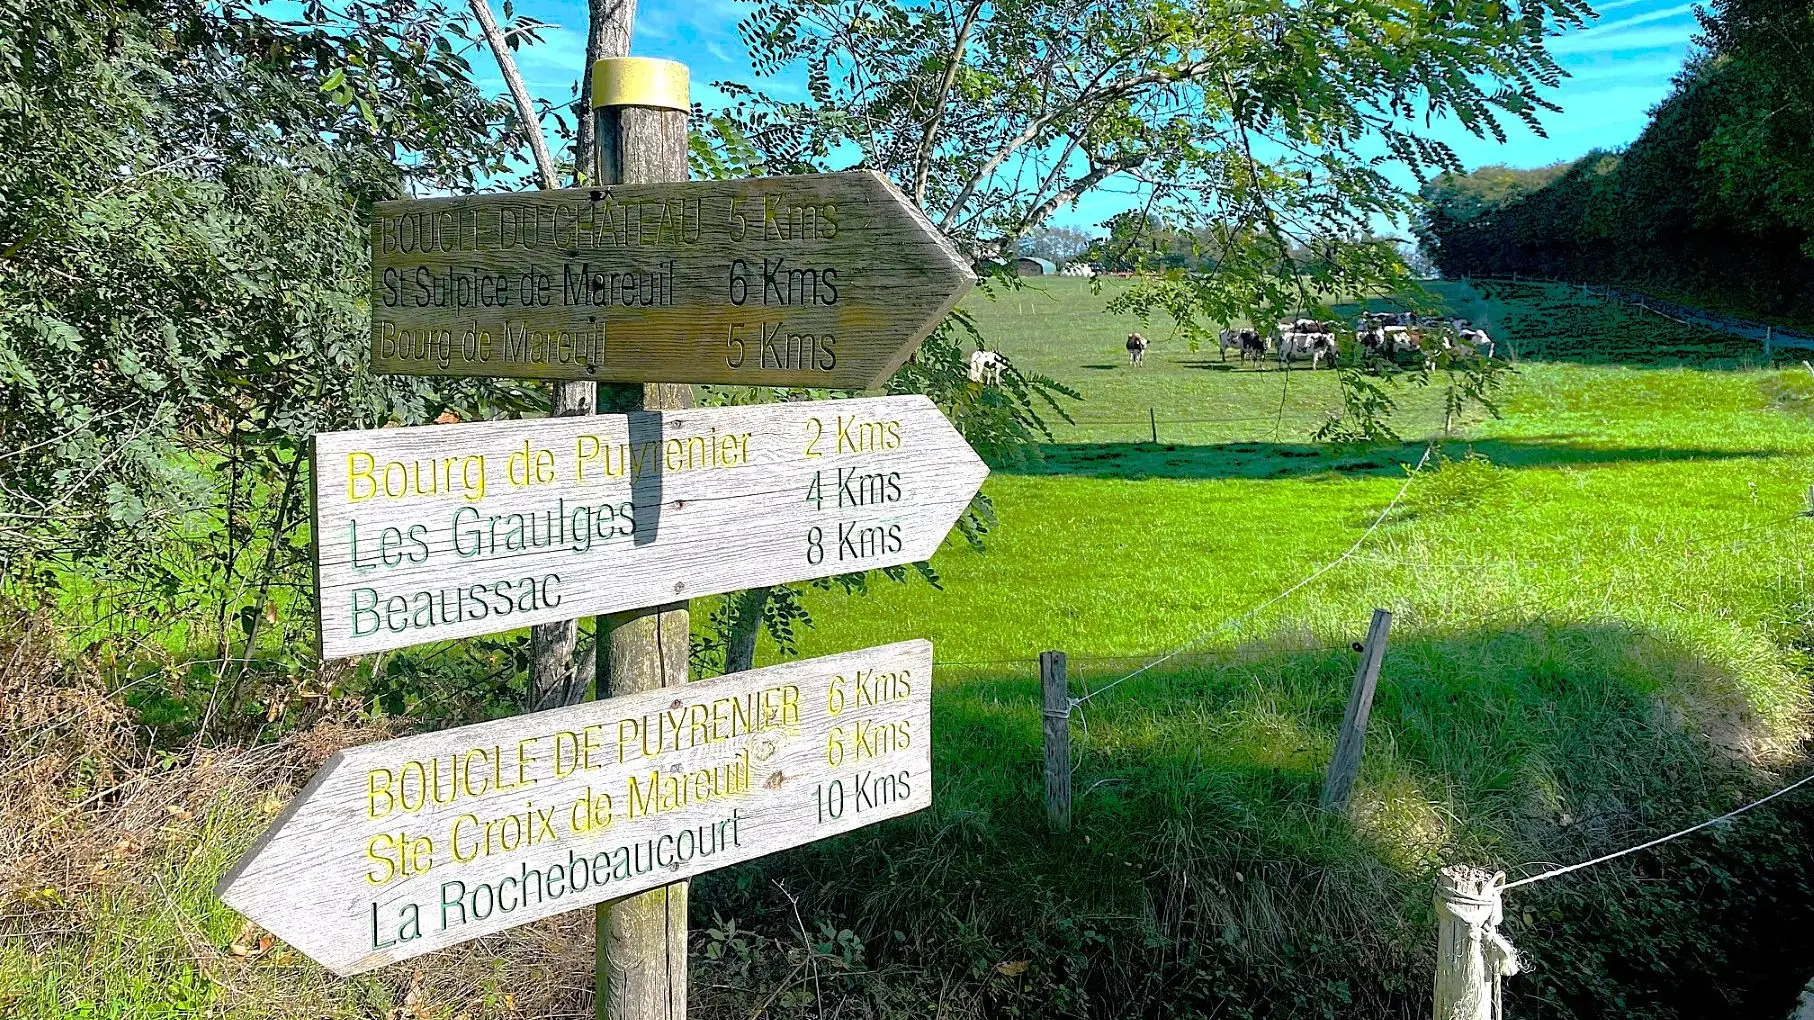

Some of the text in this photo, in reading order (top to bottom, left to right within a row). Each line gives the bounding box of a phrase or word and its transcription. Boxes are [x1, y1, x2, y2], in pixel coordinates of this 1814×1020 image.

[381, 188, 701, 256] BOUCLE DU CHÂTEAU
[729, 197, 839, 242] 5 Kms
[382, 260, 674, 314] St Sulpice de Mareuil
[729, 258, 839, 306] 6 Kms
[380, 321, 607, 370] Bourg de Mareuil
[725, 323, 837, 370] 5 Kms
[805, 415, 901, 458] 2 Kms
[345, 427, 753, 504] Bourg de Puyrenier
[805, 466, 901, 511] 4 Kms
[350, 497, 636, 570] Les Graulges
[806, 521, 902, 565] 8 Kms
[351, 572, 561, 637] Beaussac
[828, 669, 912, 716] 6 Kms
[368, 685, 801, 821] BOUCLE DE PUYRENIER
[827, 717, 912, 766] 6 Kms
[364, 748, 751, 886] Ste Croix de Mareuil
[812, 767, 912, 824] 10 Kms
[370, 808, 742, 951] La Rochebeaucourt
